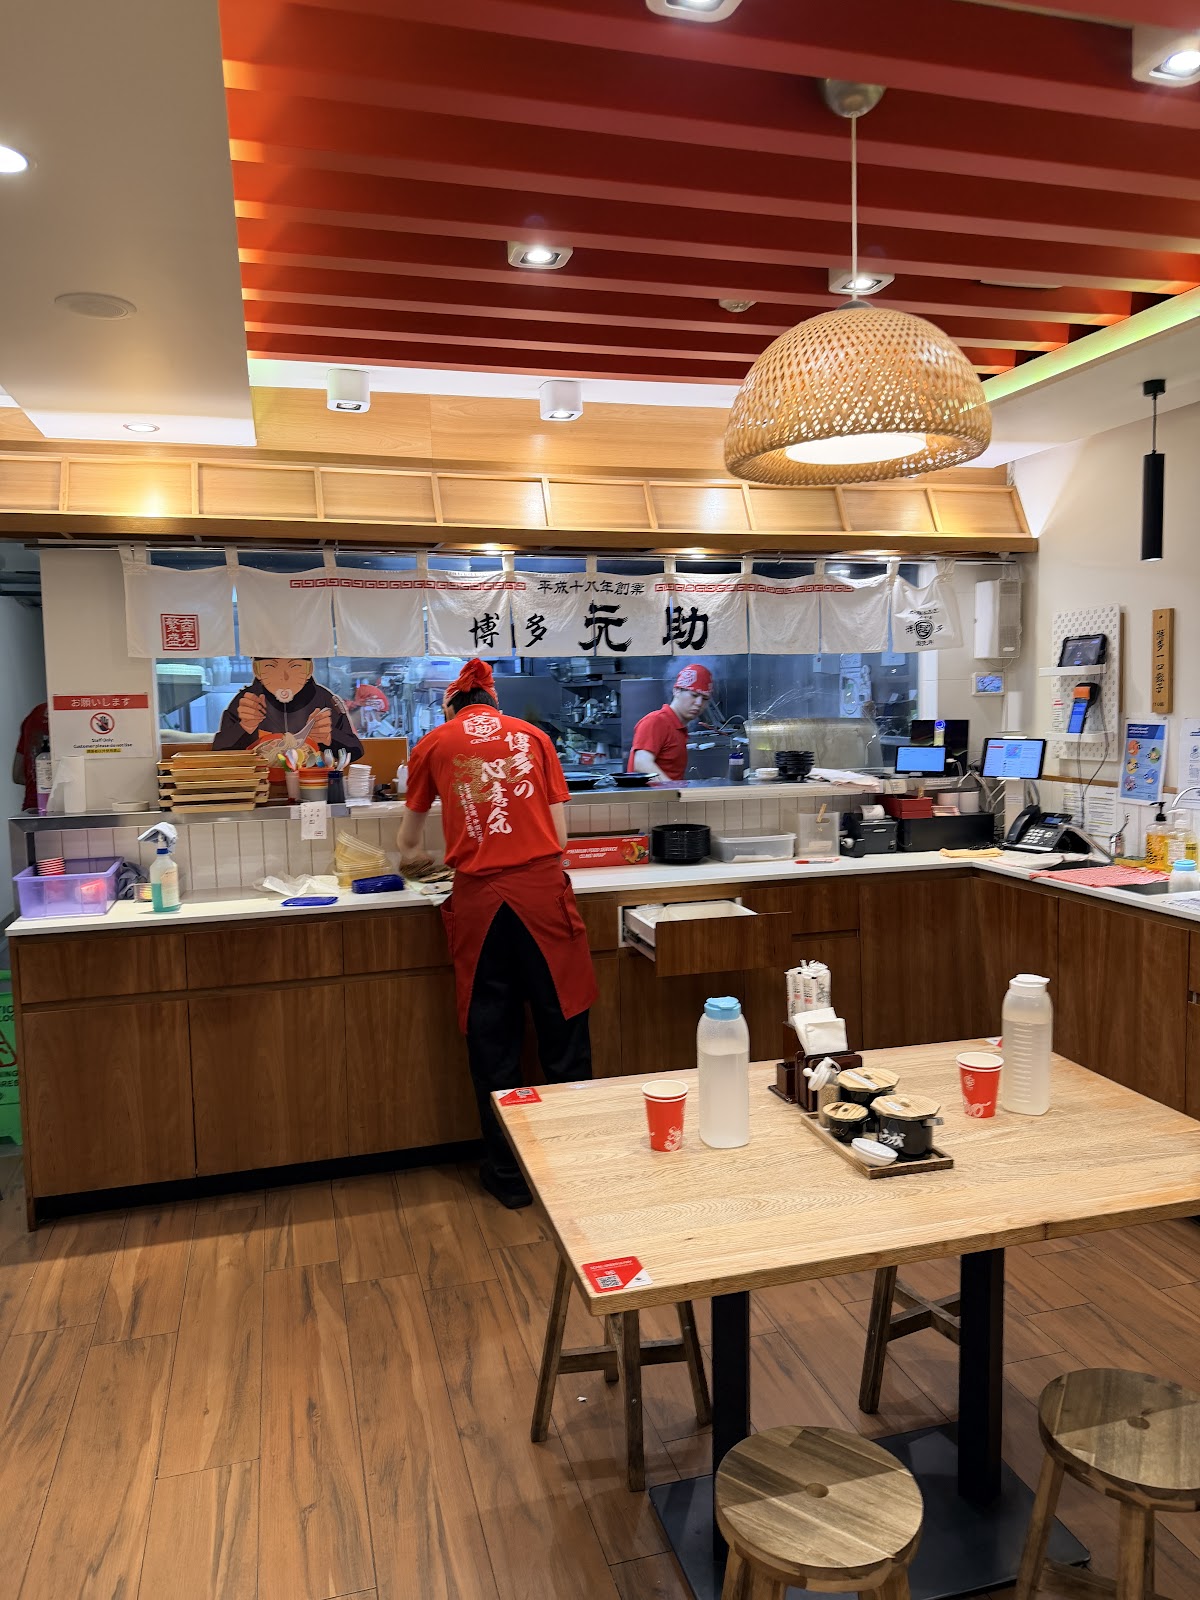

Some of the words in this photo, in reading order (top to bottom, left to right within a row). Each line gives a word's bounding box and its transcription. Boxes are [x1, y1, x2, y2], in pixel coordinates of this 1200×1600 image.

[71, 697, 131, 708] お願いします
[481, 759, 513, 836] 心意気
[504, 732, 535, 799] 博多の
